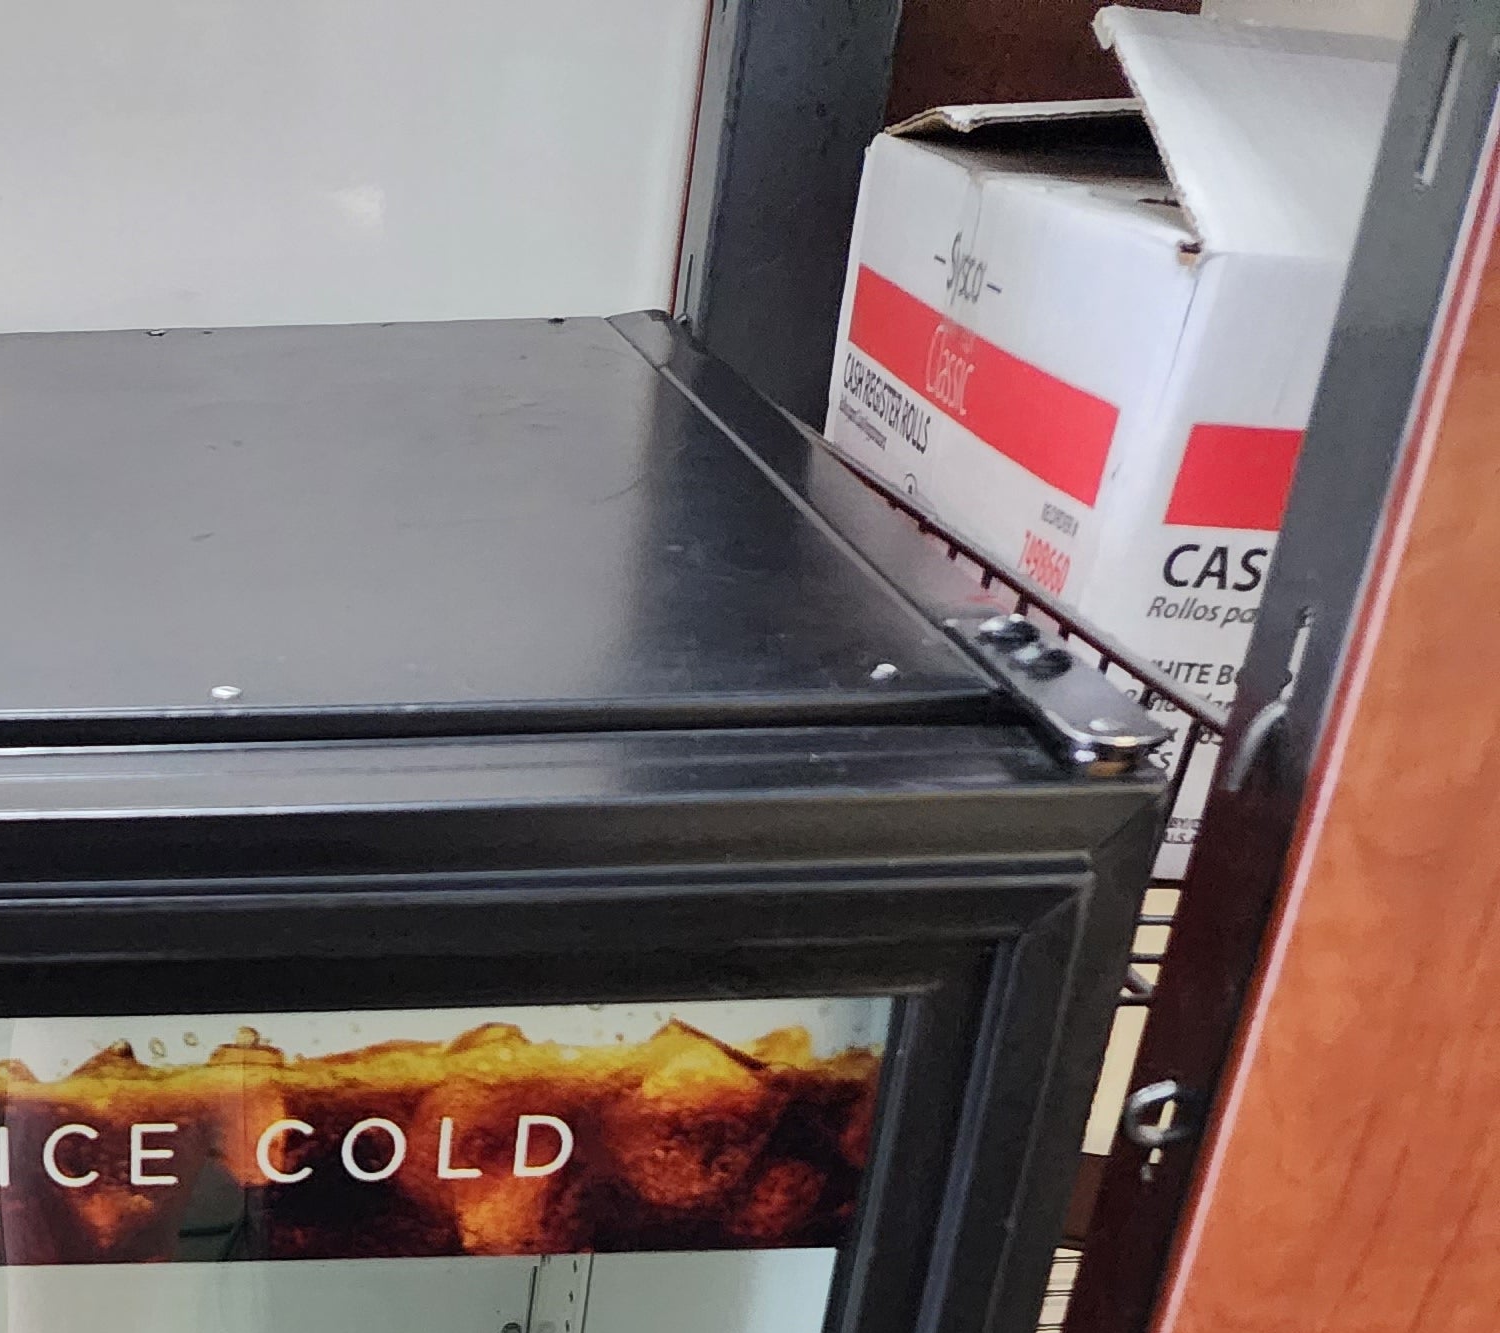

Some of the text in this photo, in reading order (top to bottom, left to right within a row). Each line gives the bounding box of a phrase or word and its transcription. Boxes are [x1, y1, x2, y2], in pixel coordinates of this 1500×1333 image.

[925, 322, 976, 417] Classic
[900, 397, 932, 455] ROLLS
[1162, 543, 1269, 592] CAS
[1146, 595, 1262, 629] Rollos pa
[1152, 658, 1214, 686] HITE
[255, 1113, 575, 1185] COLD
